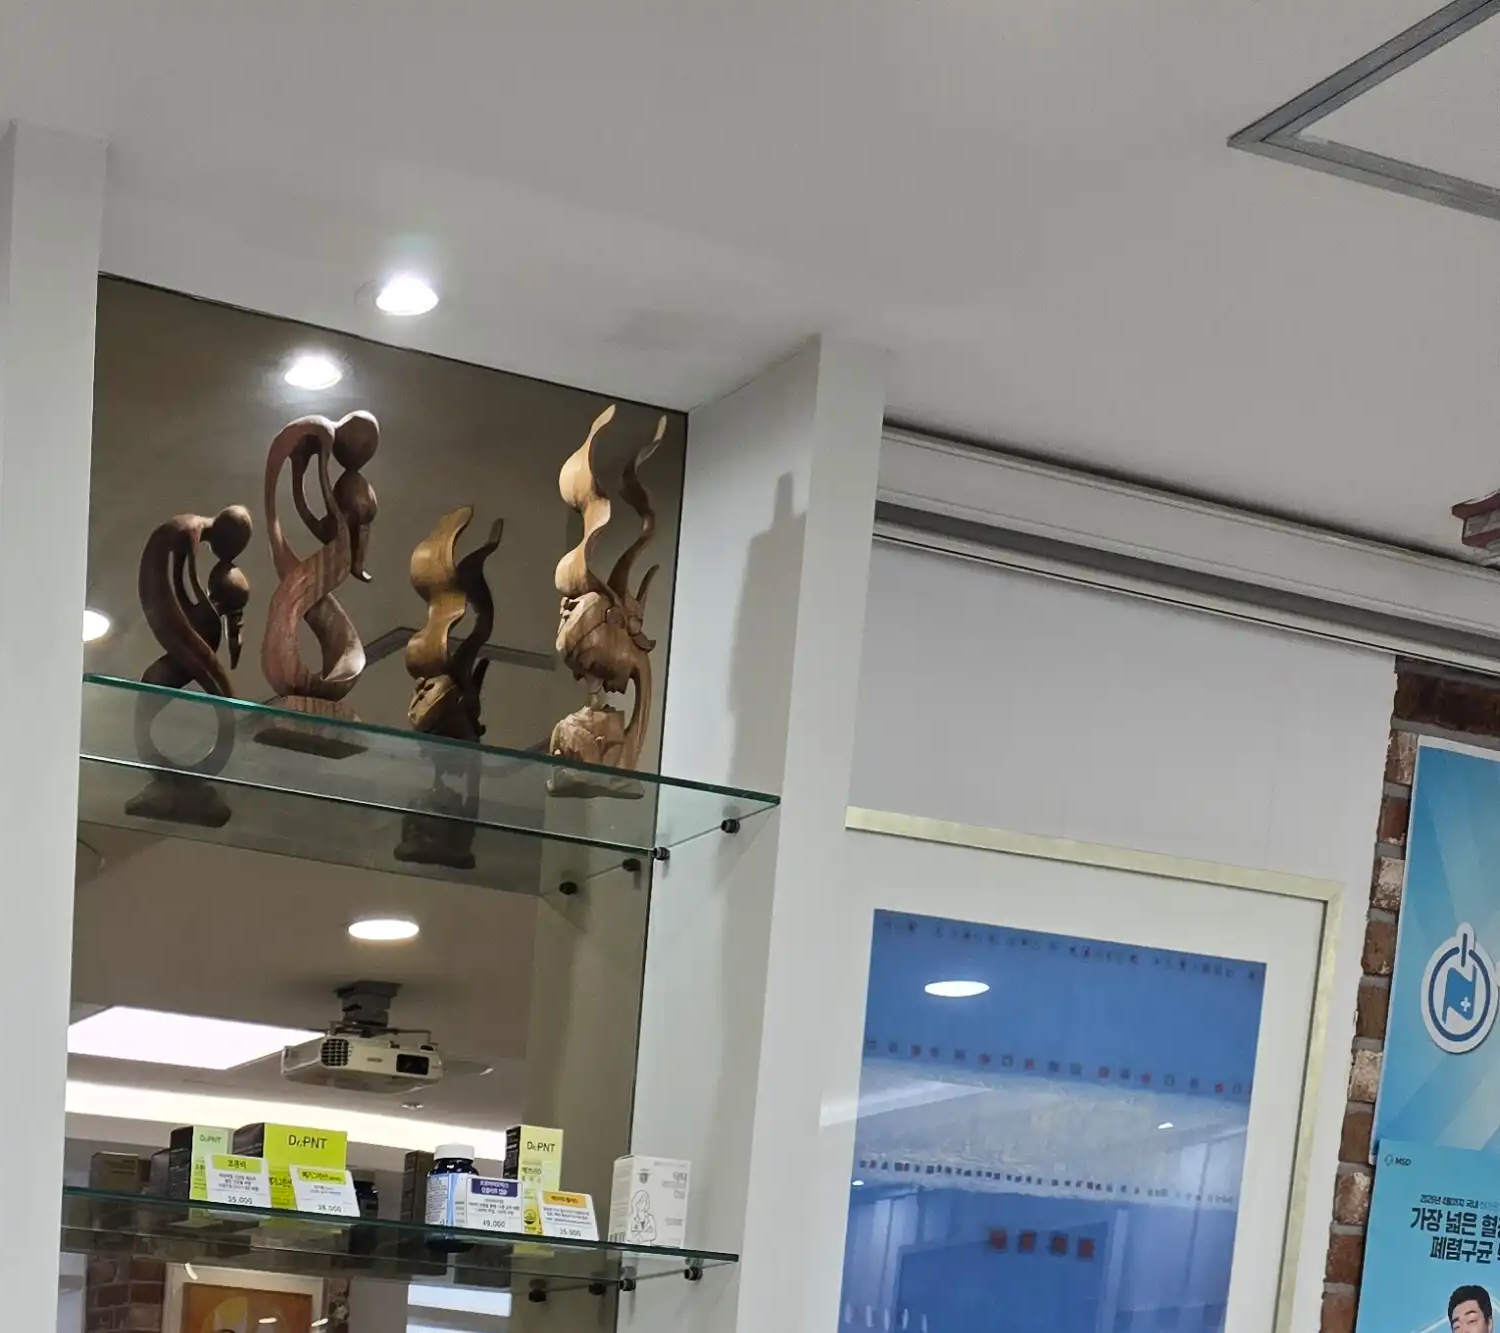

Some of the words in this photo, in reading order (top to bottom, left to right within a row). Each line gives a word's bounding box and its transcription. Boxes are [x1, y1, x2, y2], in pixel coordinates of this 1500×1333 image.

[1395, 1156, 1412, 1167] MSD
[1410, 1207, 1443, 1232] 가장
[1445, 1212, 1478, 1236] 넓은
[1430, 1236, 1494, 1265] 폐렴구균
